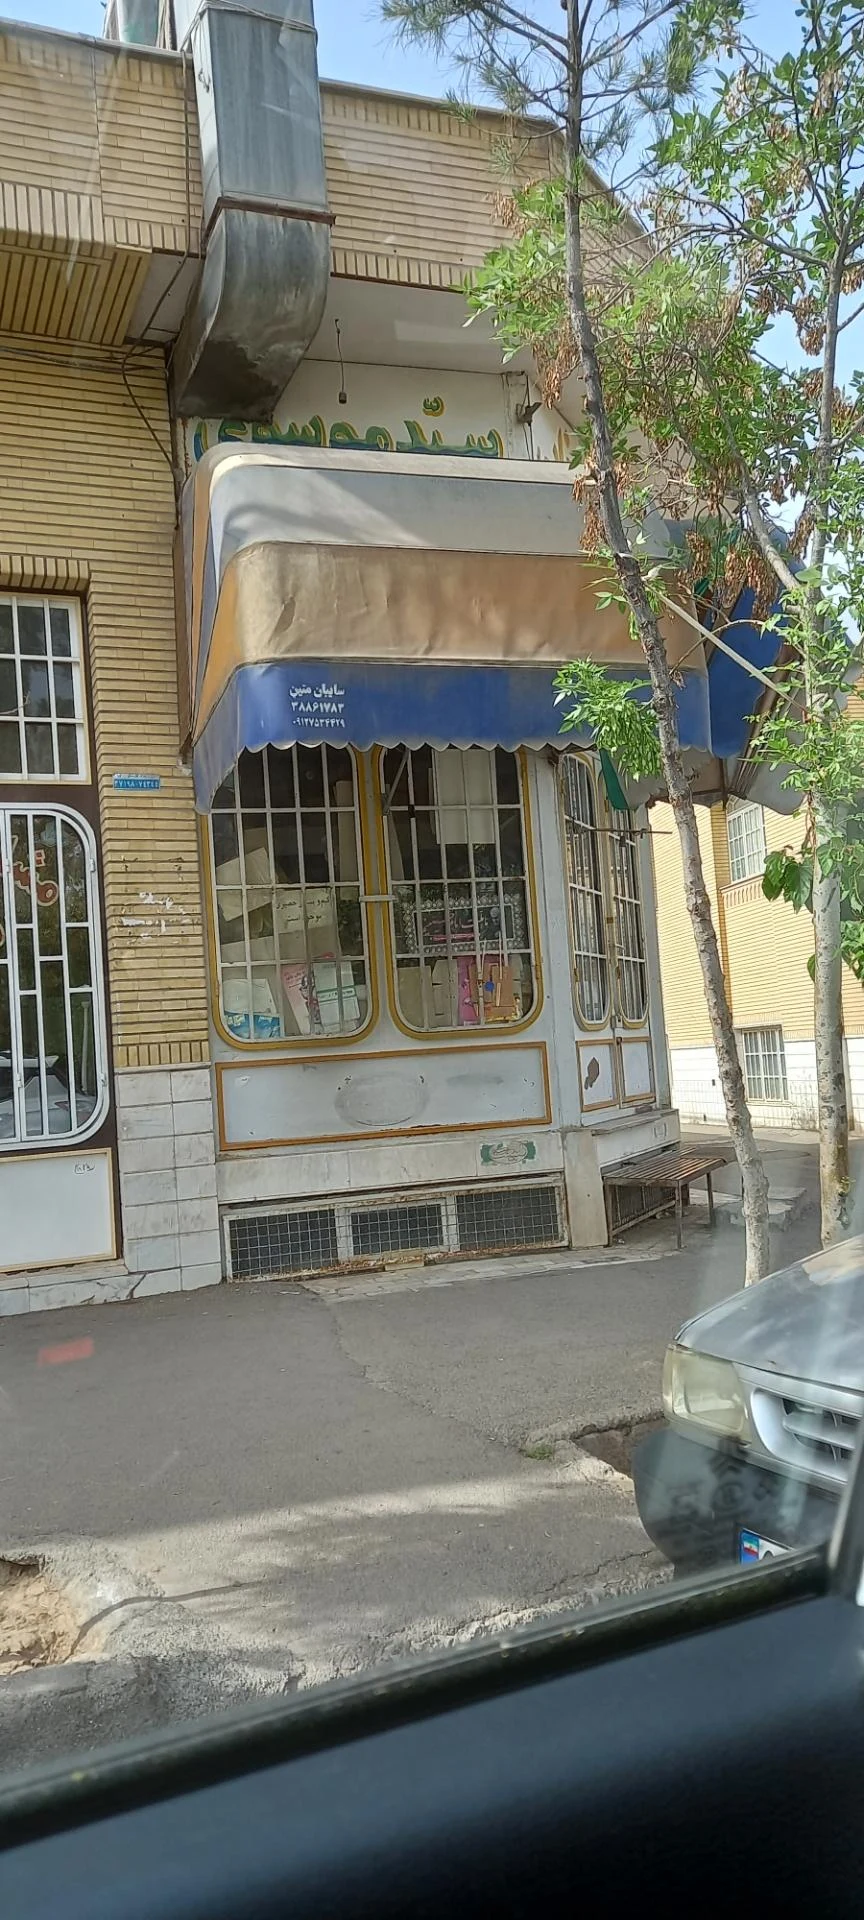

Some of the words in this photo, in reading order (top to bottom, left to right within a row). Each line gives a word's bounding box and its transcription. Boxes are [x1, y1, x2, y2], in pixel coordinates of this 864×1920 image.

[289, 684, 312, 698] متین
[313, 683, 345, 698] سایبان
[291, 701, 345, 714] ۳۸۸۶۱۷۸۳
